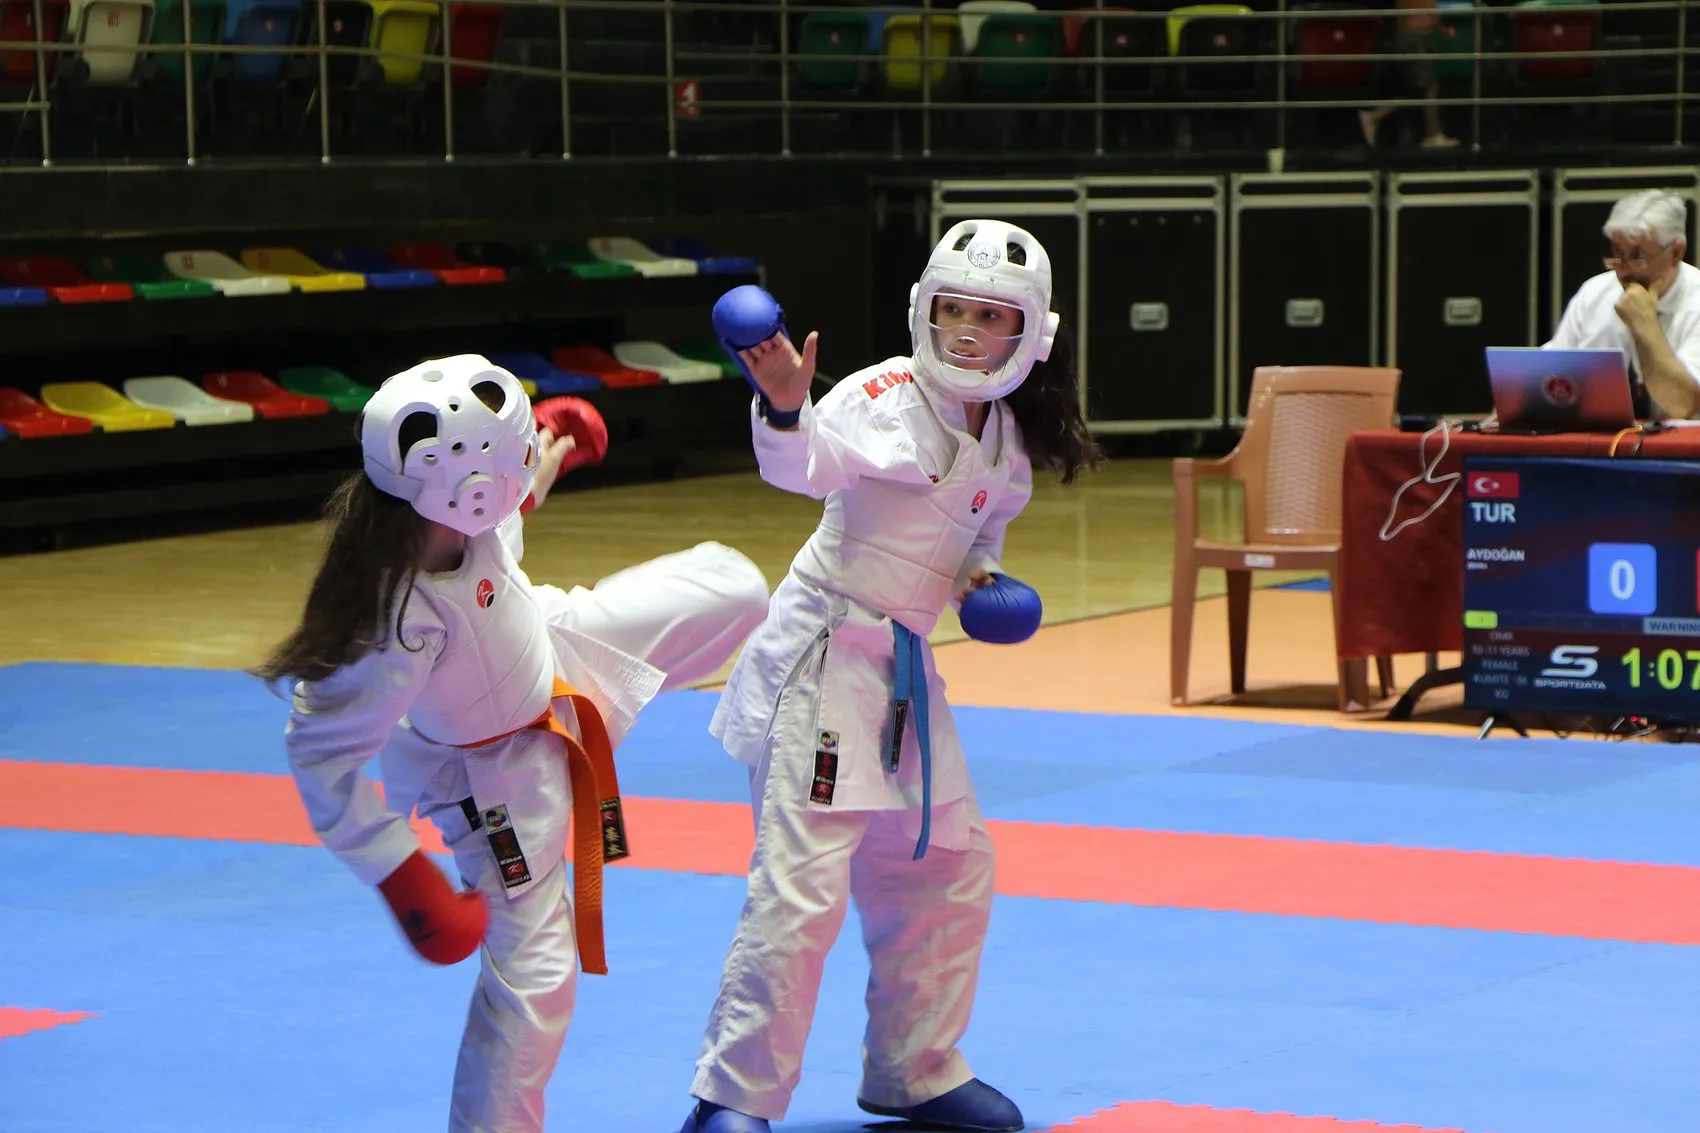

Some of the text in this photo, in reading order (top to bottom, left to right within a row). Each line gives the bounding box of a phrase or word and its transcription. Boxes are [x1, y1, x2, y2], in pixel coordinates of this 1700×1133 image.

[1471, 502, 1516, 523] TUR
[1467, 546, 1525, 561] AYDOĞAN
[1609, 559, 1635, 600] 0
[1621, 646, 1700, 690] 1:07
[1534, 679, 1607, 689] SPORTDATA
